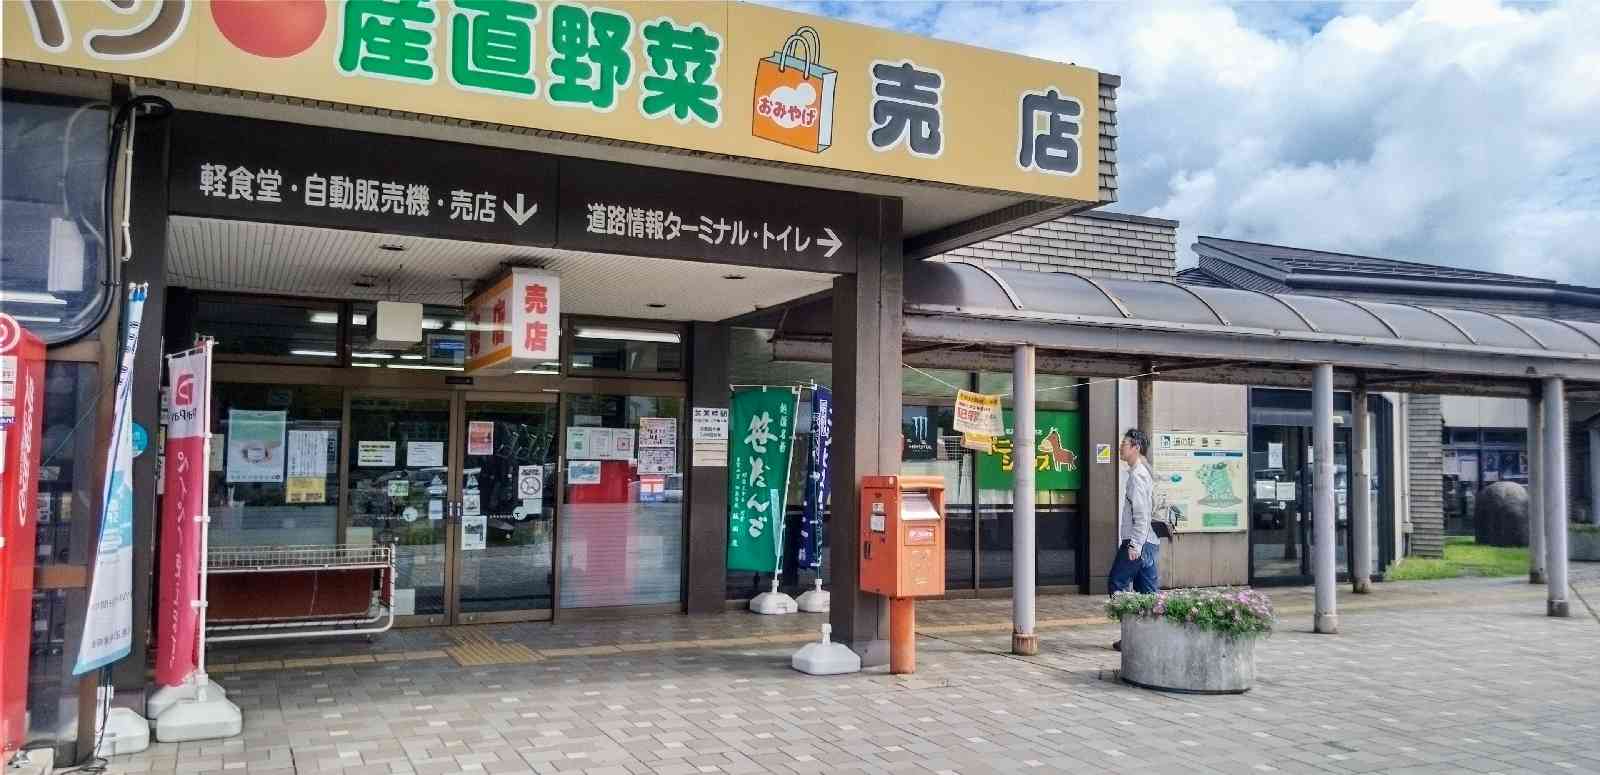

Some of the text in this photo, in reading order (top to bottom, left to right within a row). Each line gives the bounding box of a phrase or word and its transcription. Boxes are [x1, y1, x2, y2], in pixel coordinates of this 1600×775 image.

[336, 0, 721, 128] 産直野菜
[757, 96, 818, 129] おみやげ
[524, 283, 549, 353] 売店
[744, 411, 779, 538] 笹だんご
